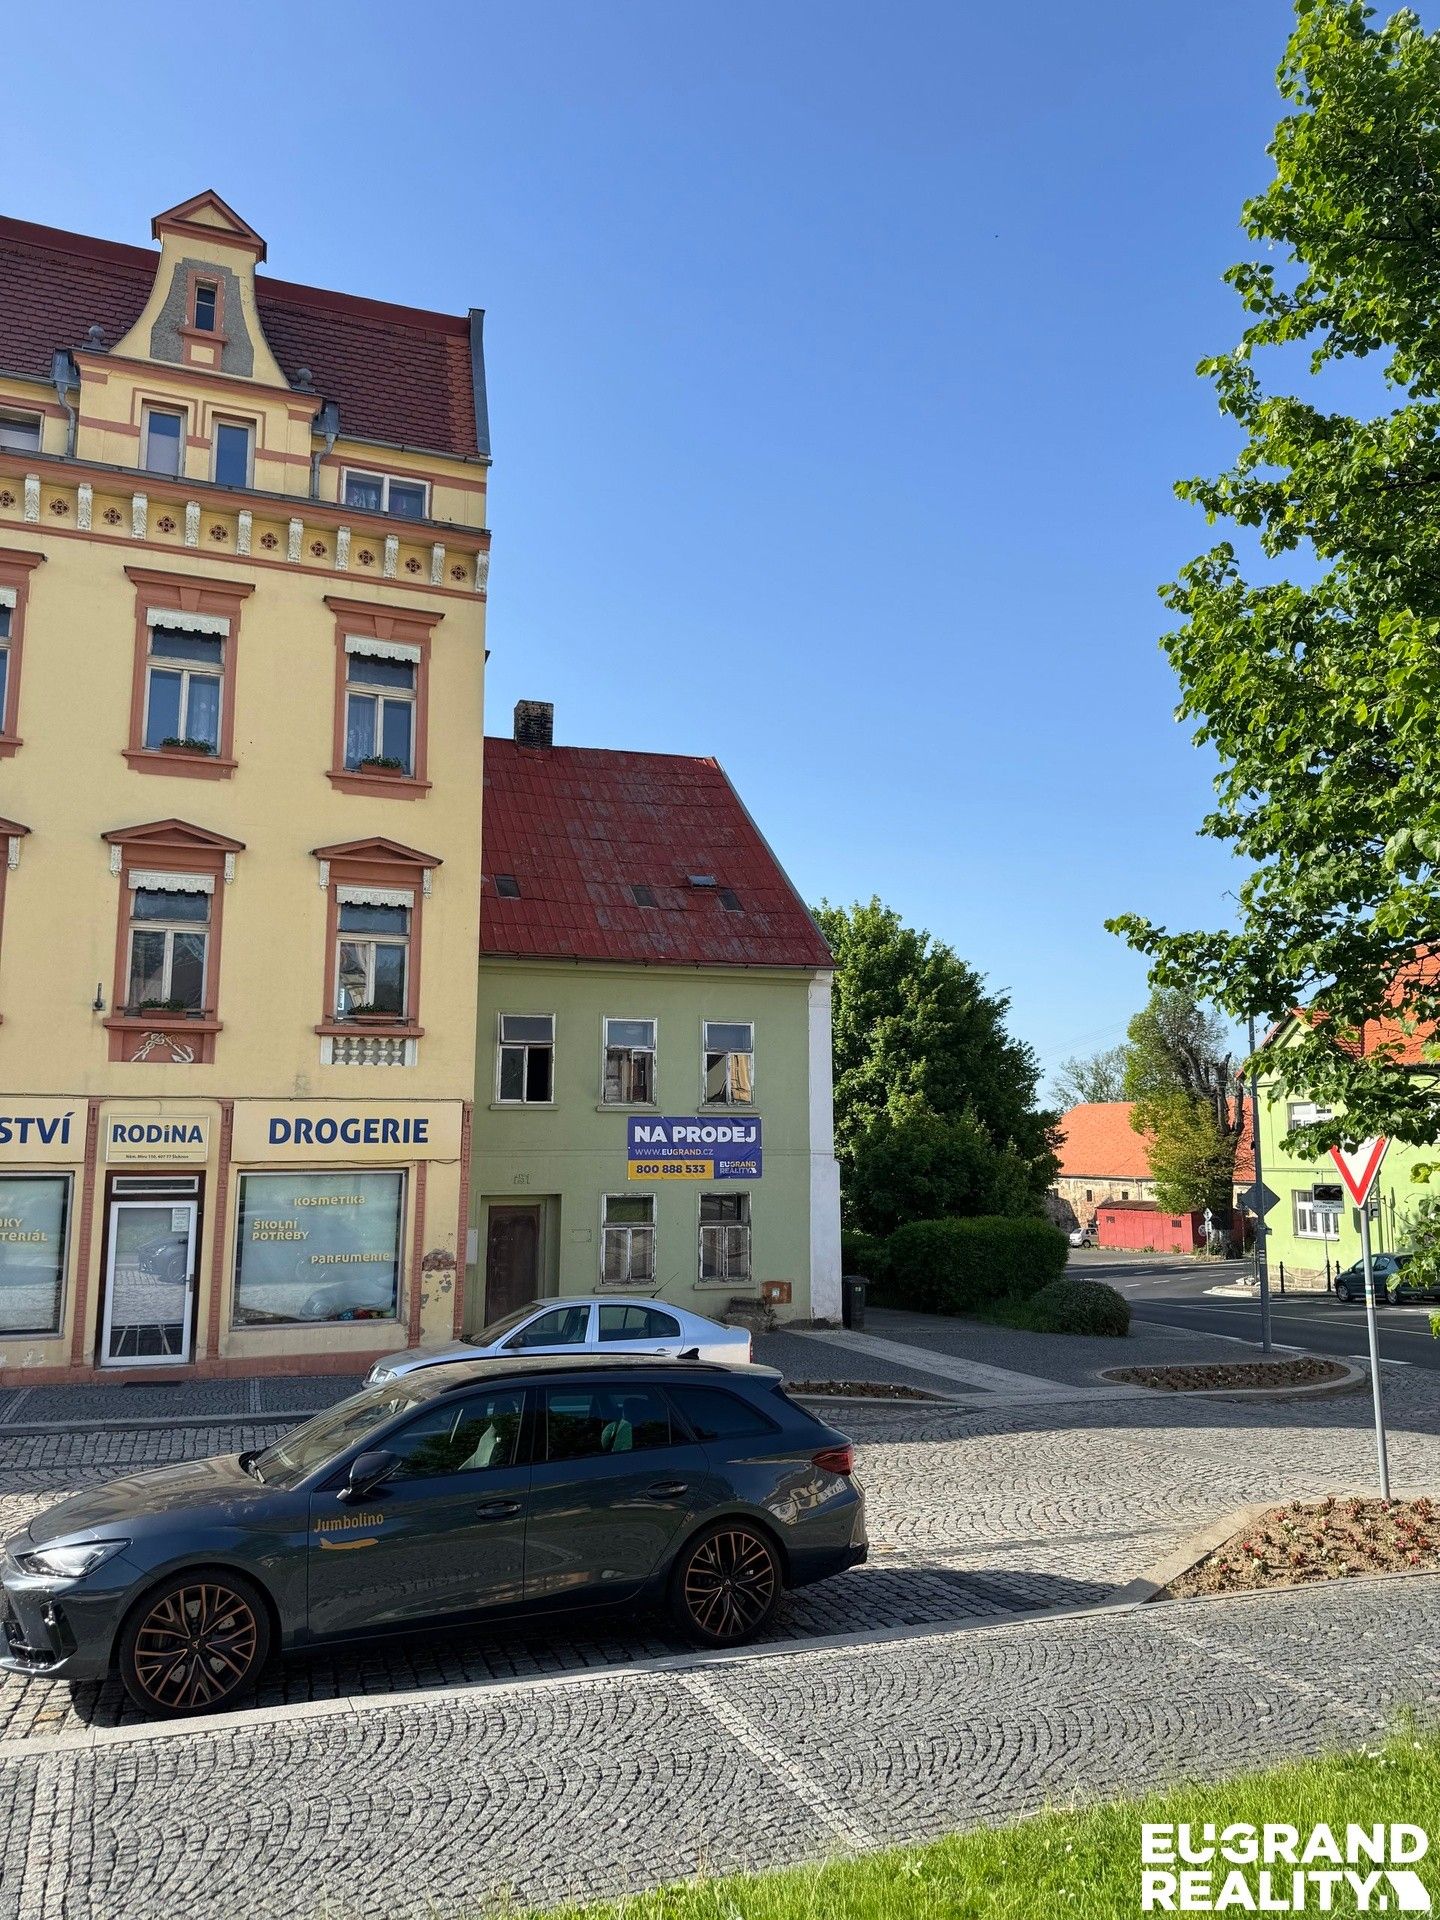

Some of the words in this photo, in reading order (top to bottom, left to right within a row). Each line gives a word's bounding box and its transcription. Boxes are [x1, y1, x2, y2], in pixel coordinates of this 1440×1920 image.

[0, 1112, 75, 1144] STVÍ
[268, 1118, 429, 1144] DROGERIE
[634, 1126, 667, 1143] NA
[672, 1126, 757, 1143] PRODEJ
[635, 1148, 714, 1156] WWW.EUGRAND.CZ
[636, 1165, 660, 1174] 800
[662, 1165, 683, 1174] 888
[685, 1165, 706, 1174] 533
[313, 1512, 384, 1533] Jumbolino
